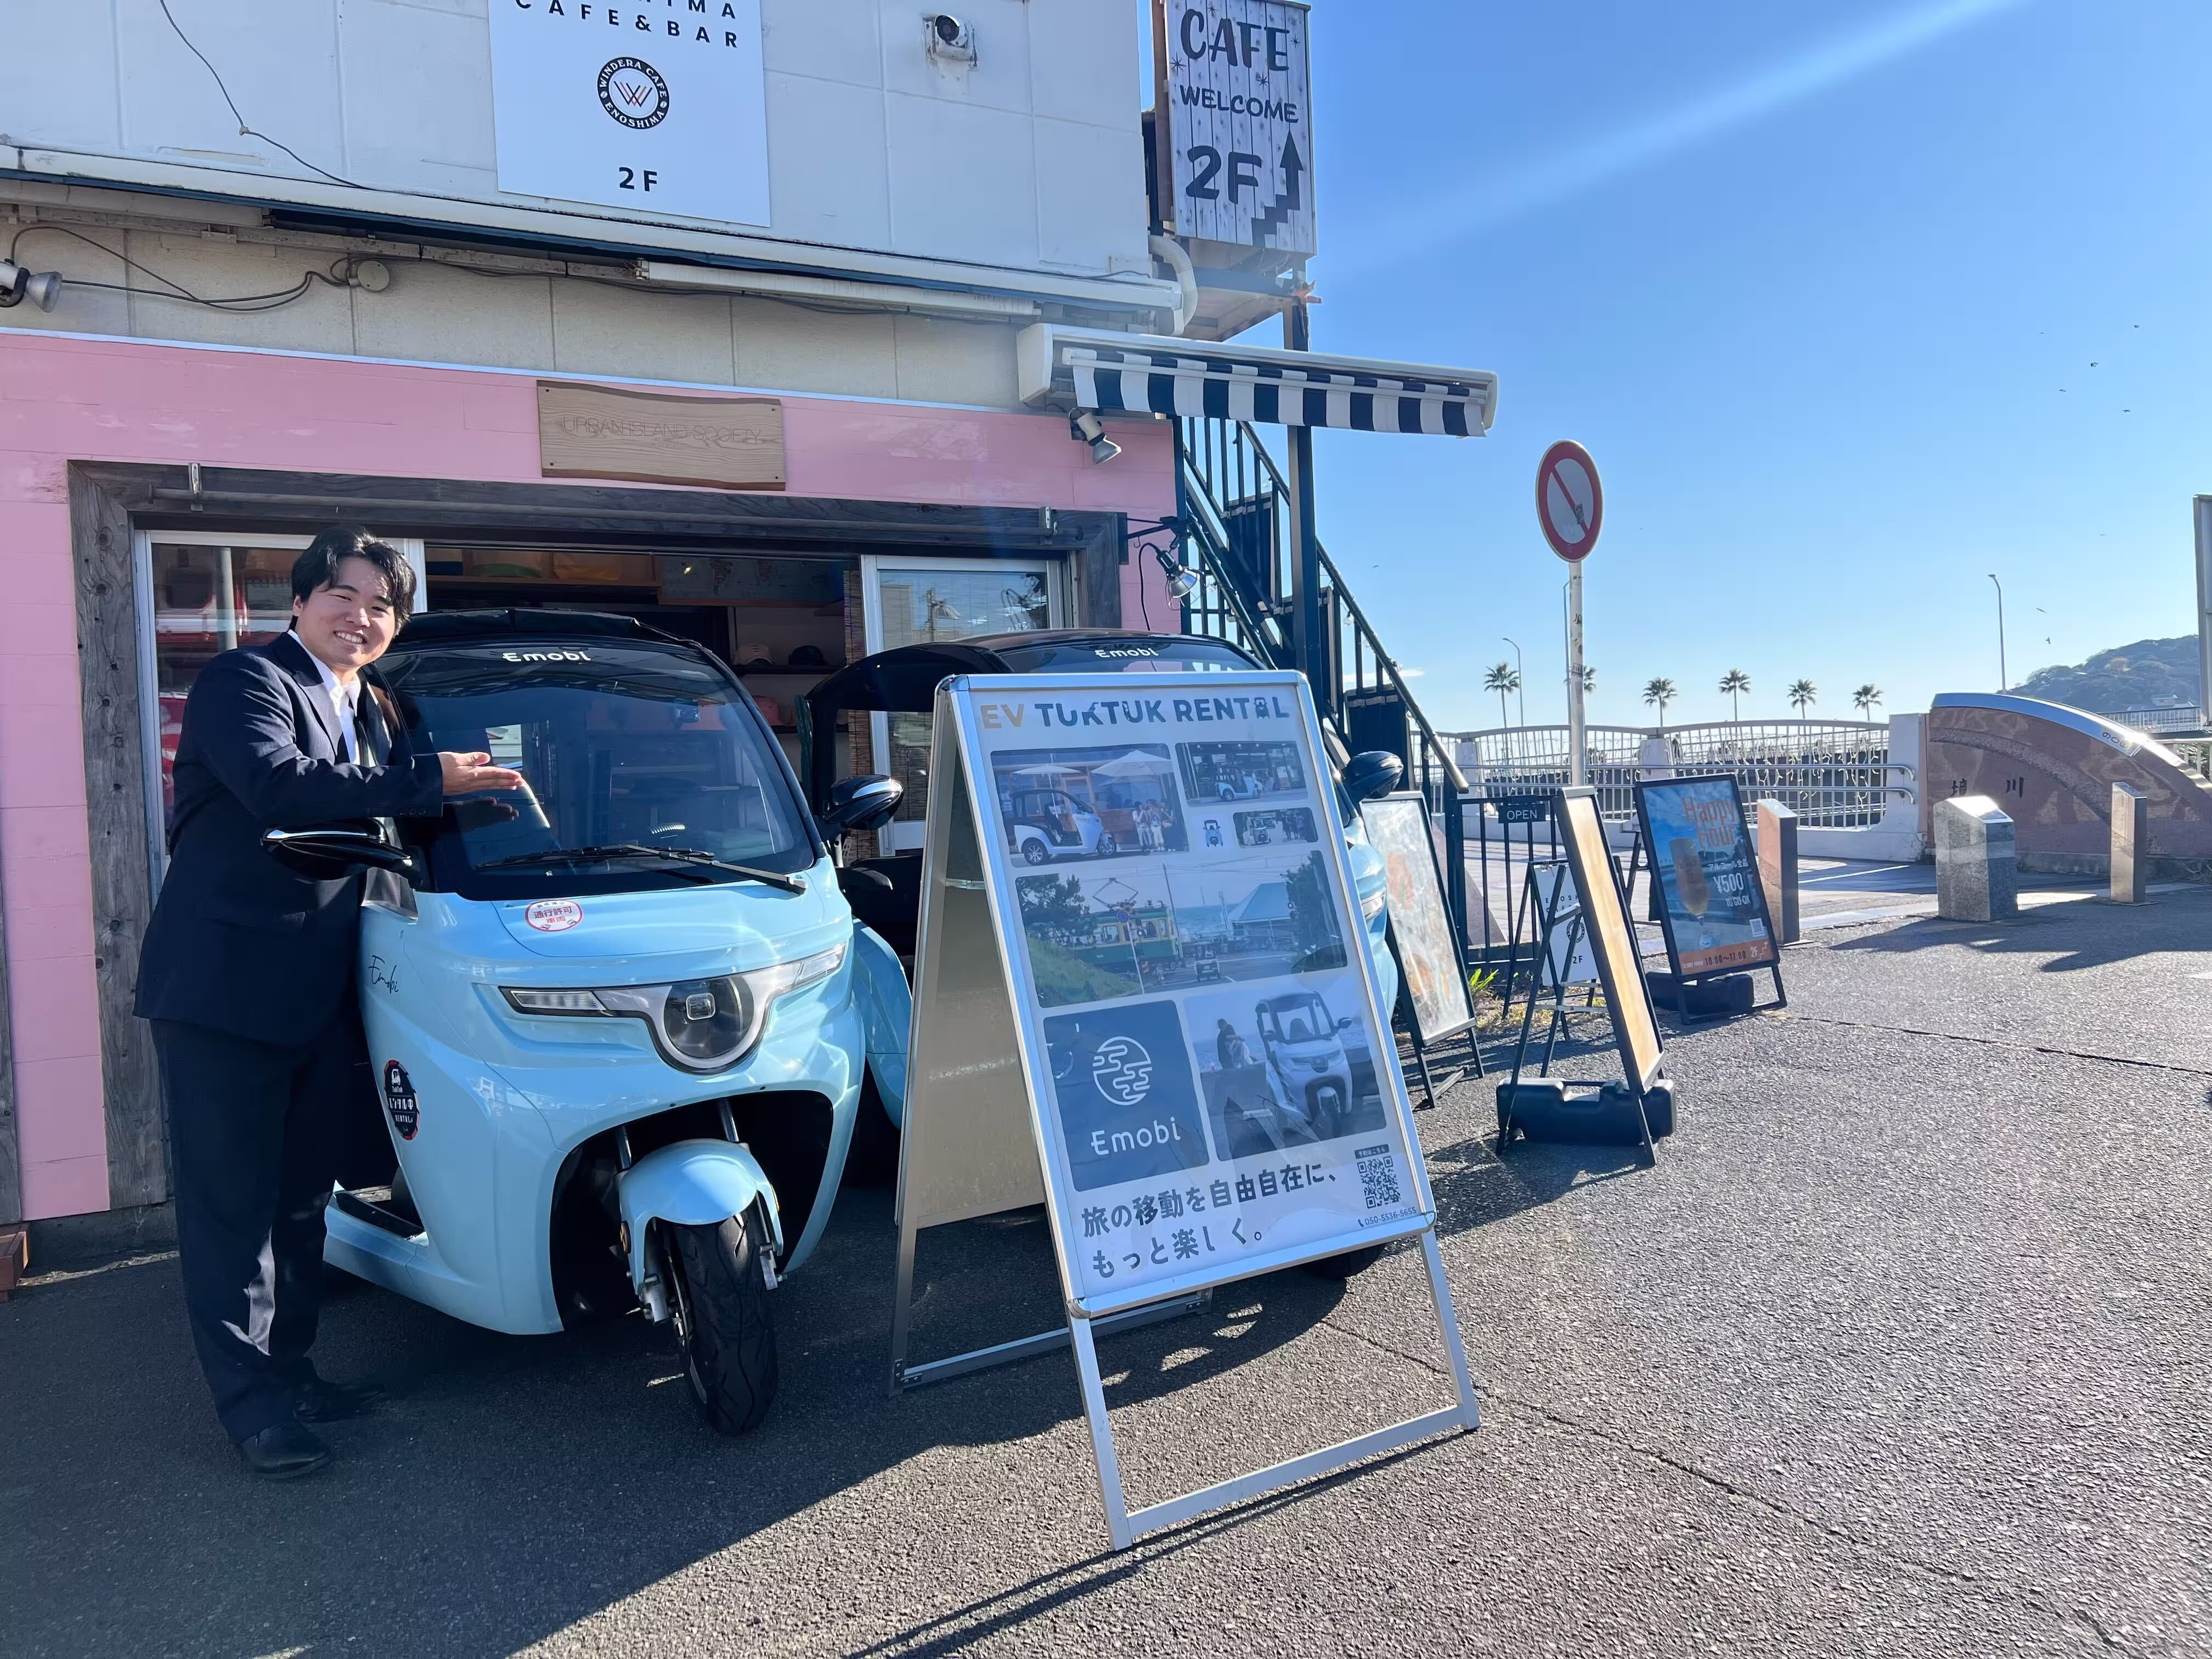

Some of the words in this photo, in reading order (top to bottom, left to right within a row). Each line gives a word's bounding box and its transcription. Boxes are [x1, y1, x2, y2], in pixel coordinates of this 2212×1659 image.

[1180, 9, 1290, 71] CAFE
[599, 59, 642, 88] WINDERA
[646, 67, 667, 98] CAFE
[604, 101, 665, 128] ENOSHIMA
[1180, 84, 1299, 123] WELCOME
[618, 167, 658, 192] 2F
[1185, 145, 1262, 205] 2F
[563, 416, 624, 436] URBAN
[629, 421, 687, 439] ISLAND
[693, 425, 762, 444] SOCIETY
[503, 651, 591, 662] Emobi
[1094, 647, 1159, 658] Emobi
[980, 703, 1025, 729] EV
[1035, 700, 1167, 727] TUKTUK
[1506, 809, 1537, 820] OPEN
[1713, 872, 1744, 894] ¥500
[534, 906, 572, 919] 通行許可
[1725, 898, 1734, 907] TO
[1734, 896, 1742, 906] GO
[1742, 895, 1751, 905] OK
[1572, 955, 1583, 964] 2F
[1091, 1116, 1182, 1156] Emobi
[1081, 1161, 1336, 1239] 旅の移動を自由自在に、
[1364, 1206, 1417, 1225] 050-5536-5655
[1092, 1217, 1263, 1279] もっと楽しく。
